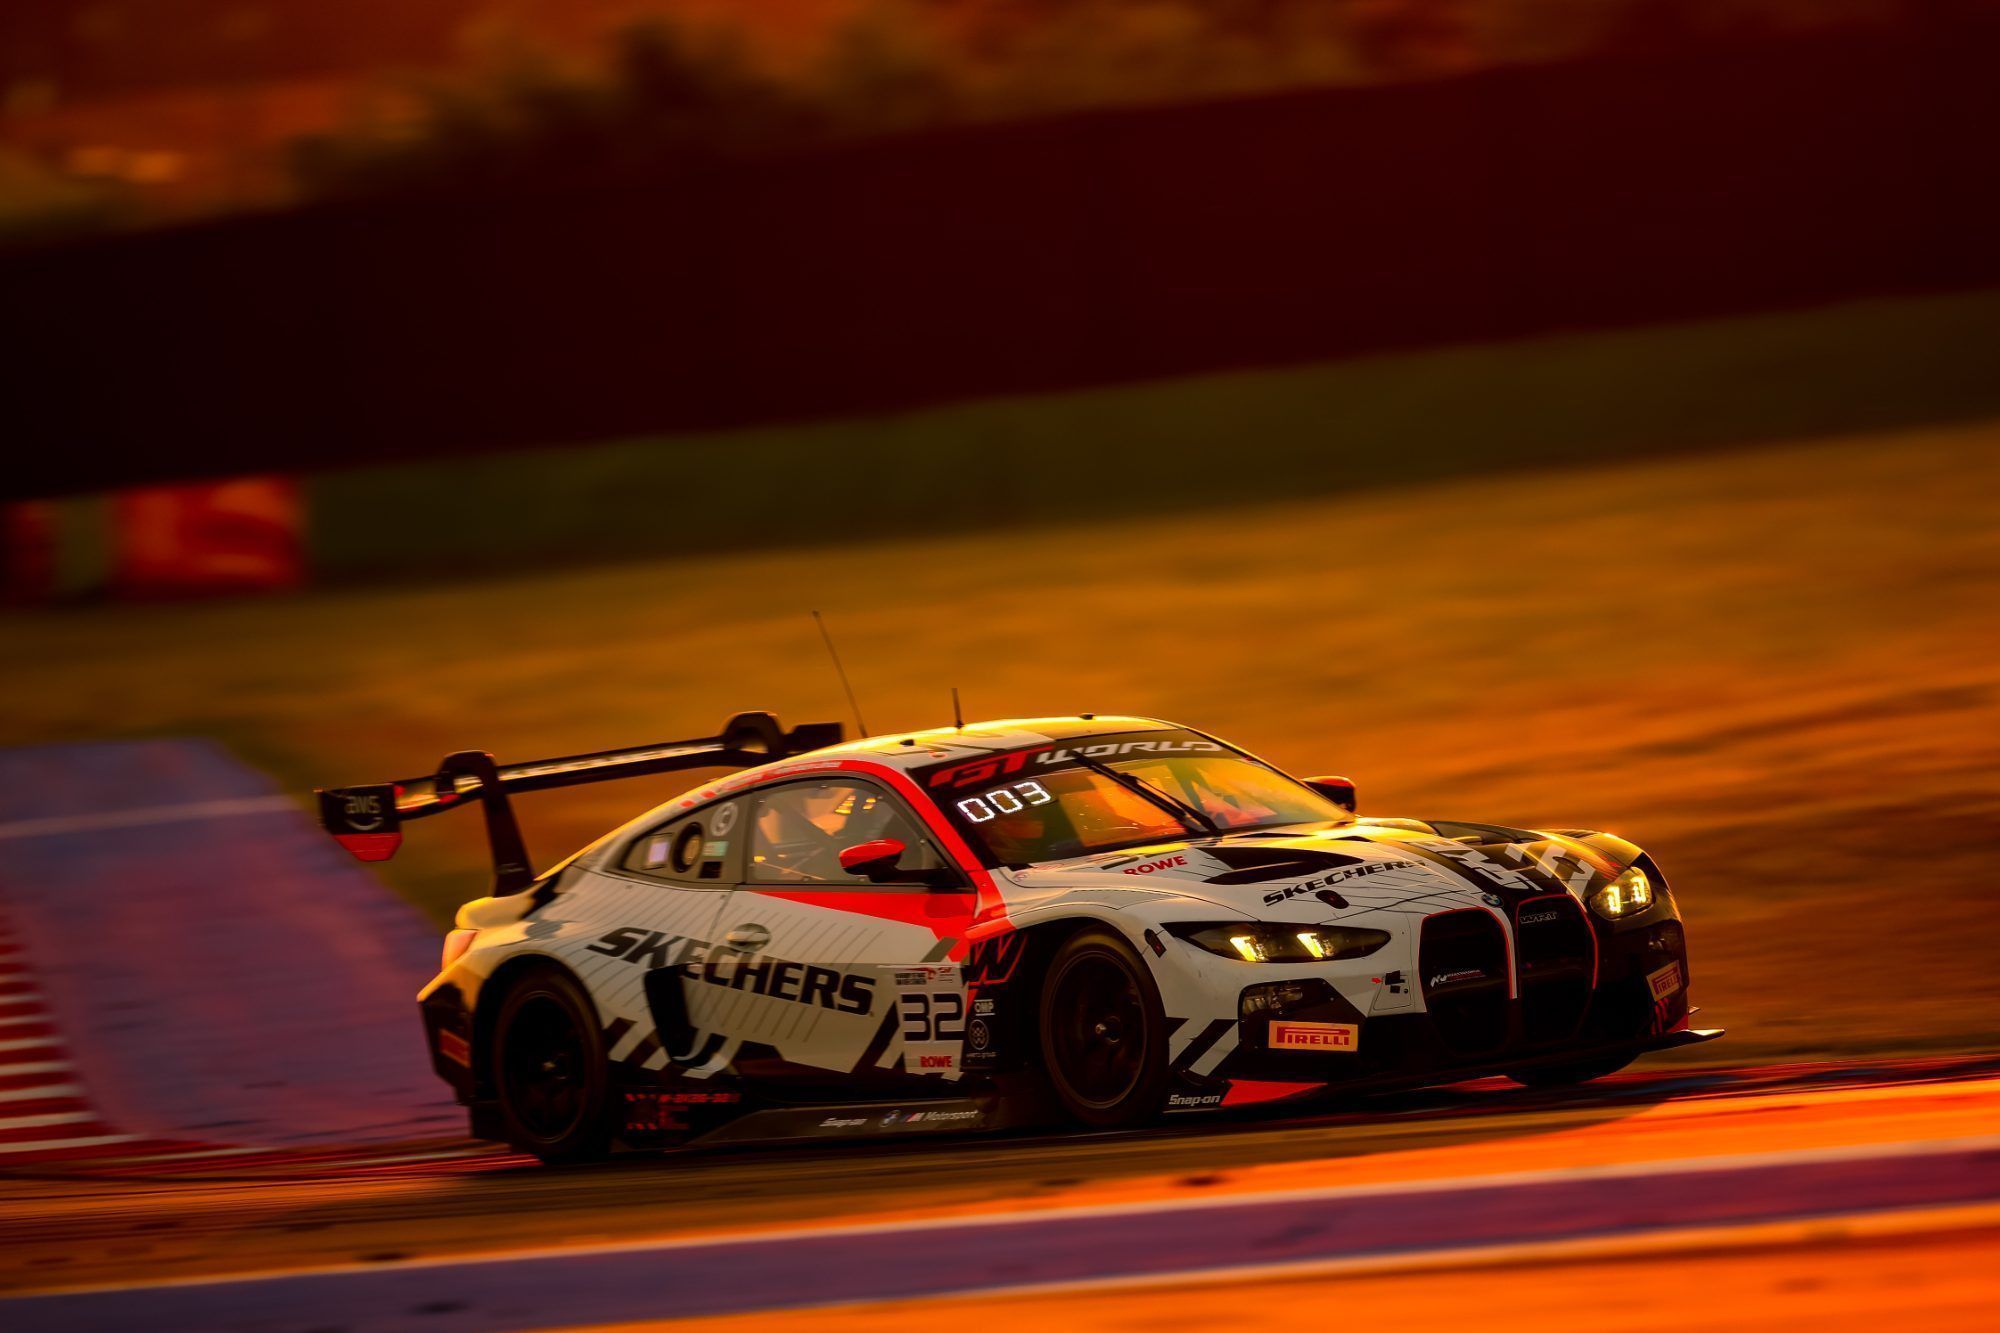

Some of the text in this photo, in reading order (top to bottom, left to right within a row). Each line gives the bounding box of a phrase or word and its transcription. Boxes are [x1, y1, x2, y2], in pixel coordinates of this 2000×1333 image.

[1036, 741, 1223, 765] WORLD
[344, 795, 383, 815] aws
[957, 782, 1052, 823] 003
[1124, 856, 1188, 876] ROWE
[1263, 860, 1427, 906] SKECHERS
[585, 927, 876, 1016] SKECHERS
[901, 993, 966, 1042] 32
[1276, 1026, 1350, 1046] PIRELLI
[920, 1056, 953, 1068] ROWE
[1168, 1094, 1221, 1107] Snap-on
